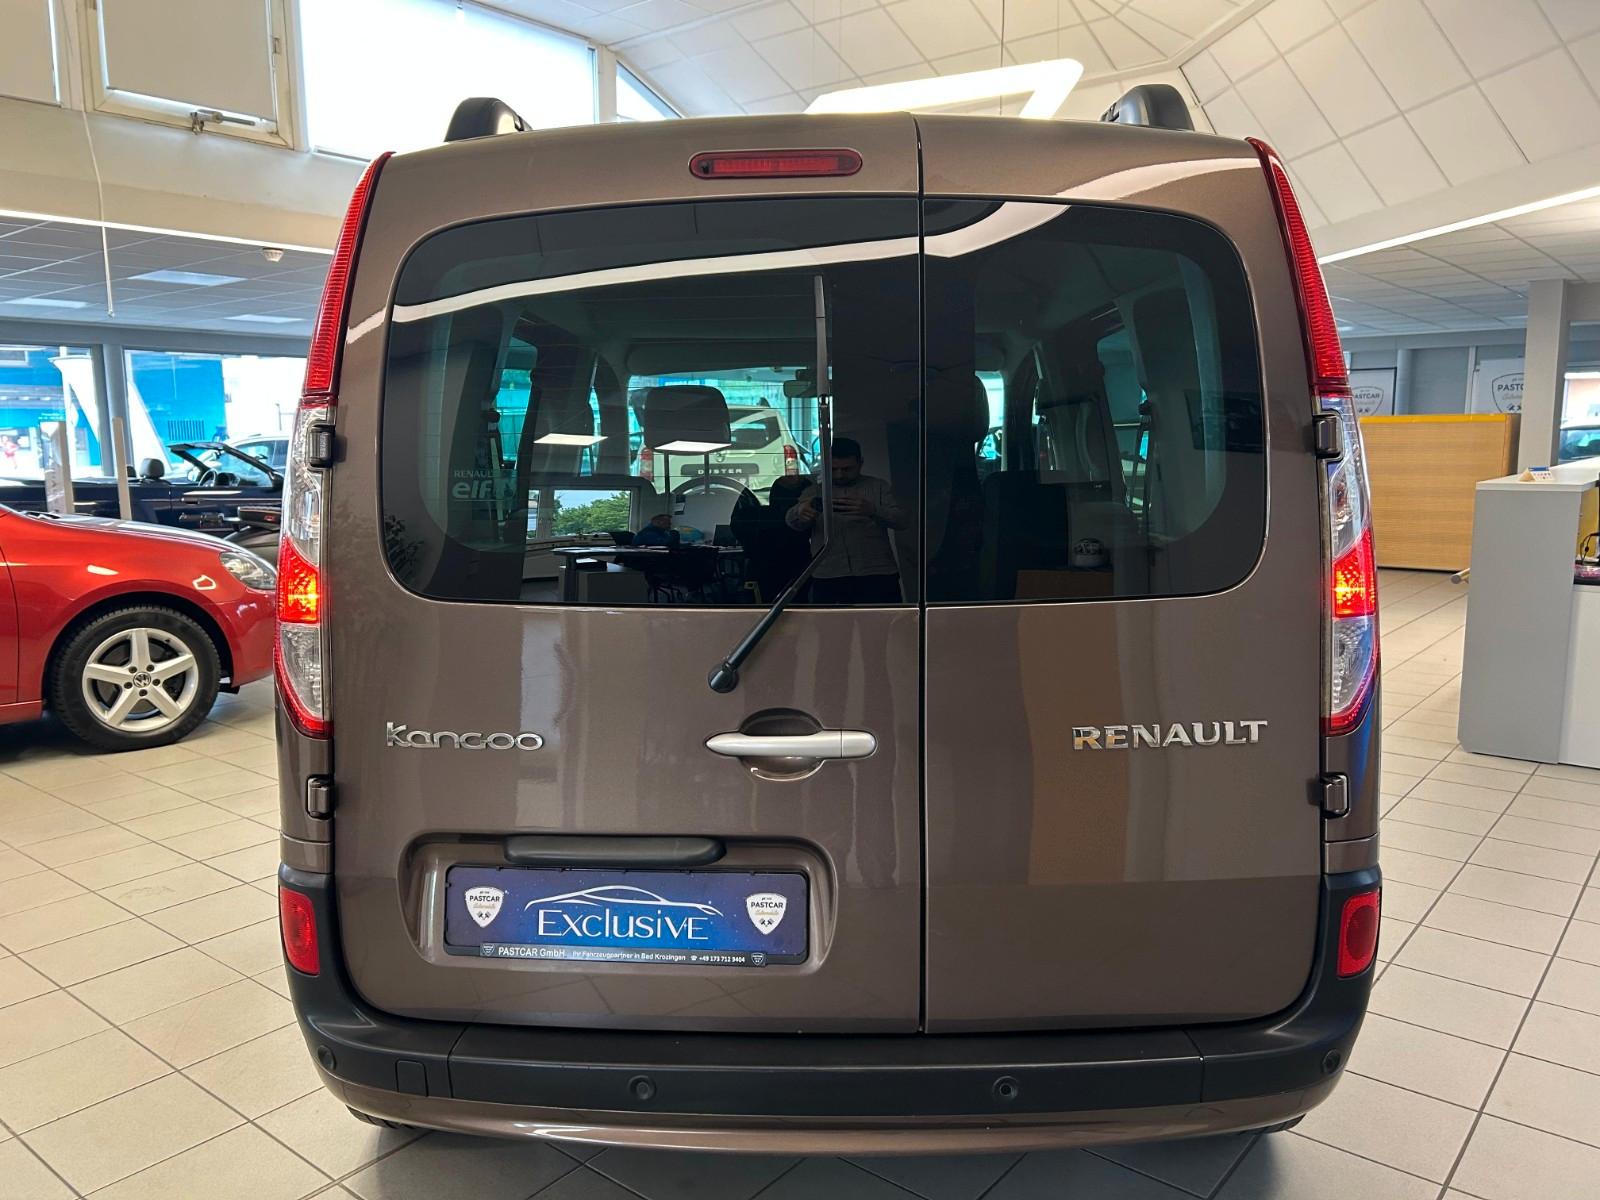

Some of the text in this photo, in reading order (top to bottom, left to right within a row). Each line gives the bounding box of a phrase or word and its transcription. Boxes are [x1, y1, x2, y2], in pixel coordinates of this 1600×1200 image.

[1497, 383, 1524, 391] PAST
[454, 470, 497, 478] RENAUL
[452, 480, 492, 499] elf
[1071, 719, 1269, 751] RENAULT
[751, 901, 784, 909] PASTCAR
[498, 946, 538, 956] PASTCAR
[540, 948, 565, 957] GmbH
[641, 952, 654, 960] Bad
[654, 953, 686, 962] Krozingen
